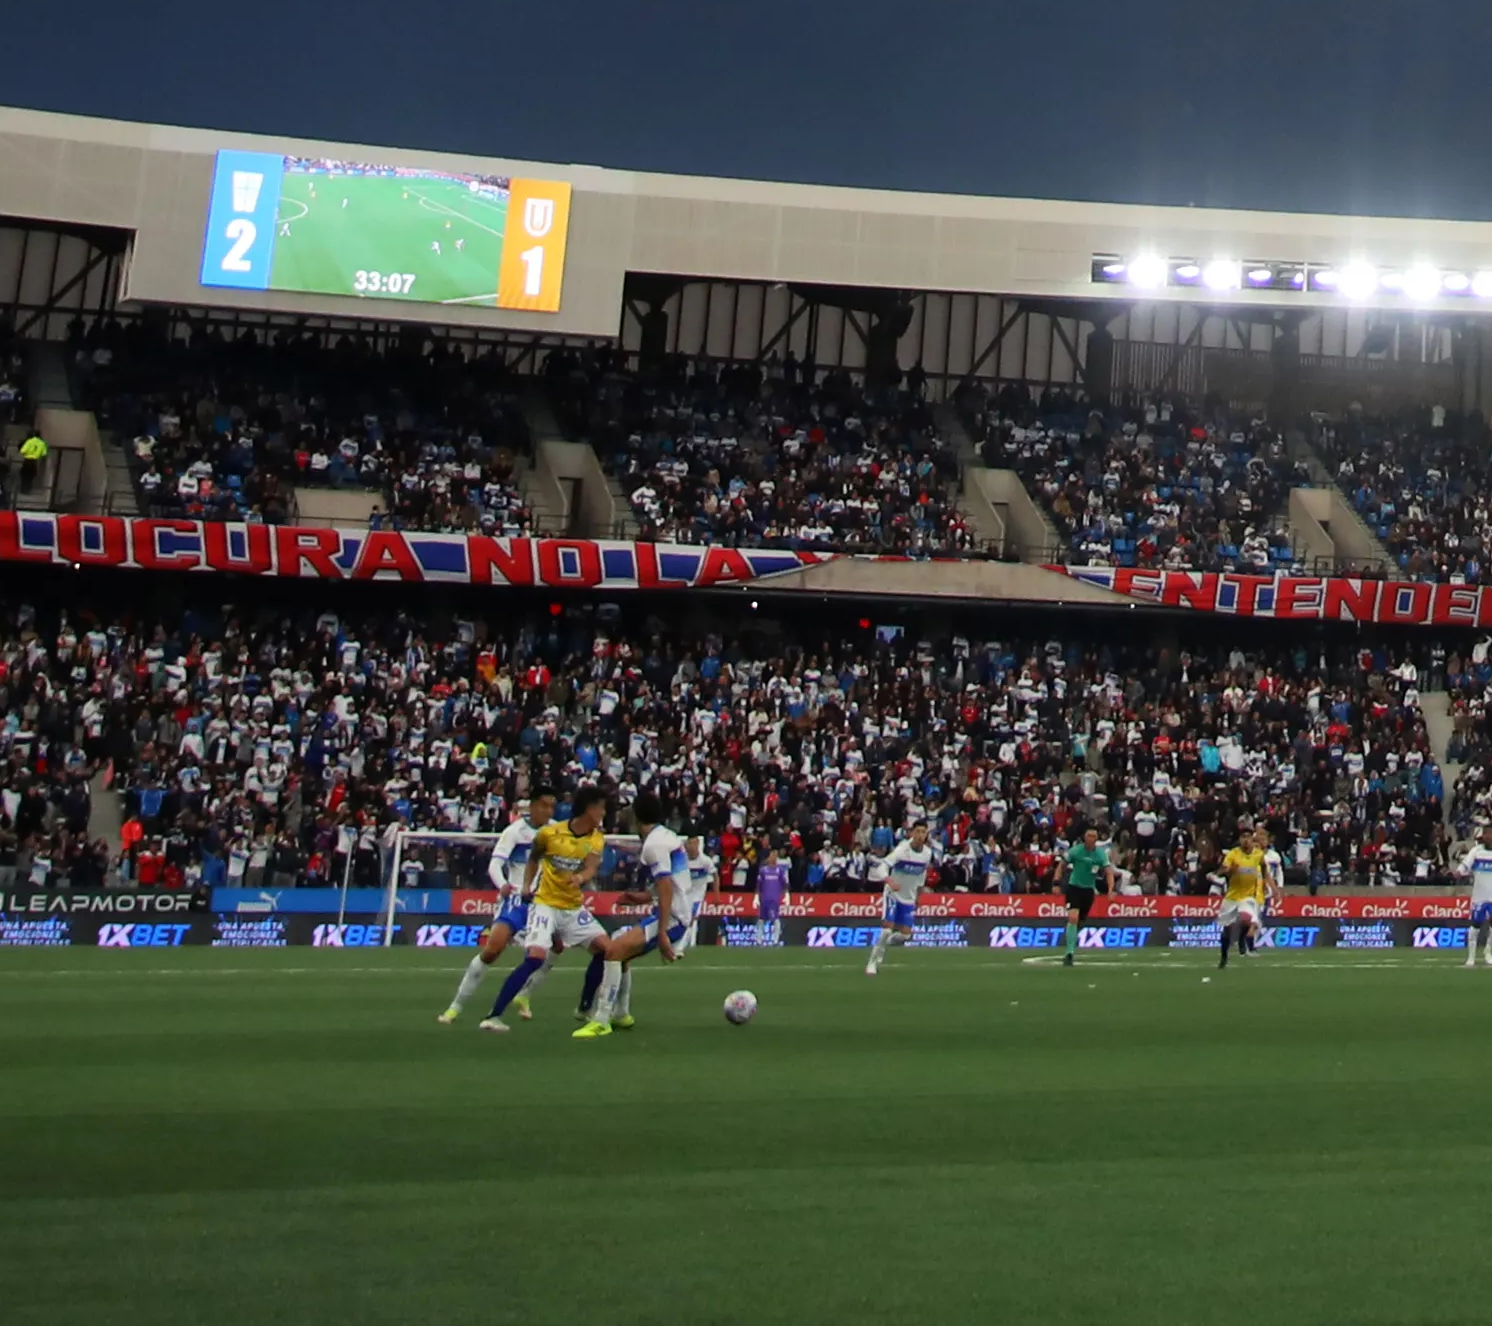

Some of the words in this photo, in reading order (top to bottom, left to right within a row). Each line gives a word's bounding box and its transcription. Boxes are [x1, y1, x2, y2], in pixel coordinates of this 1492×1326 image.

[221, 218, 252, 272] 2
[520, 246, 545, 296] 1
[353, 269, 416, 295] 33:07
[465, 534, 604, 589] NO
[634, 541, 756, 589] LA
[10, 894, 192, 912] LEAPMOTOR
[699, 901, 736, 916] laro
[830, 902, 877, 916] Claro
[970, 903, 1018, 917] Claro
[1108, 904, 1151, 917] Claro
[1171, 904, 1215, 917] Claro
[1301, 904, 1343, 918] Claro
[1362, 904, 1405, 918] Claro
[1422, 904, 1466, 918] Claro
[98, 923, 192, 946] 1XBET
[989, 926, 1065, 948] 1XBET
[1077, 927, 1152, 948] 1XBET
[1255, 928, 1320, 948] XBET
